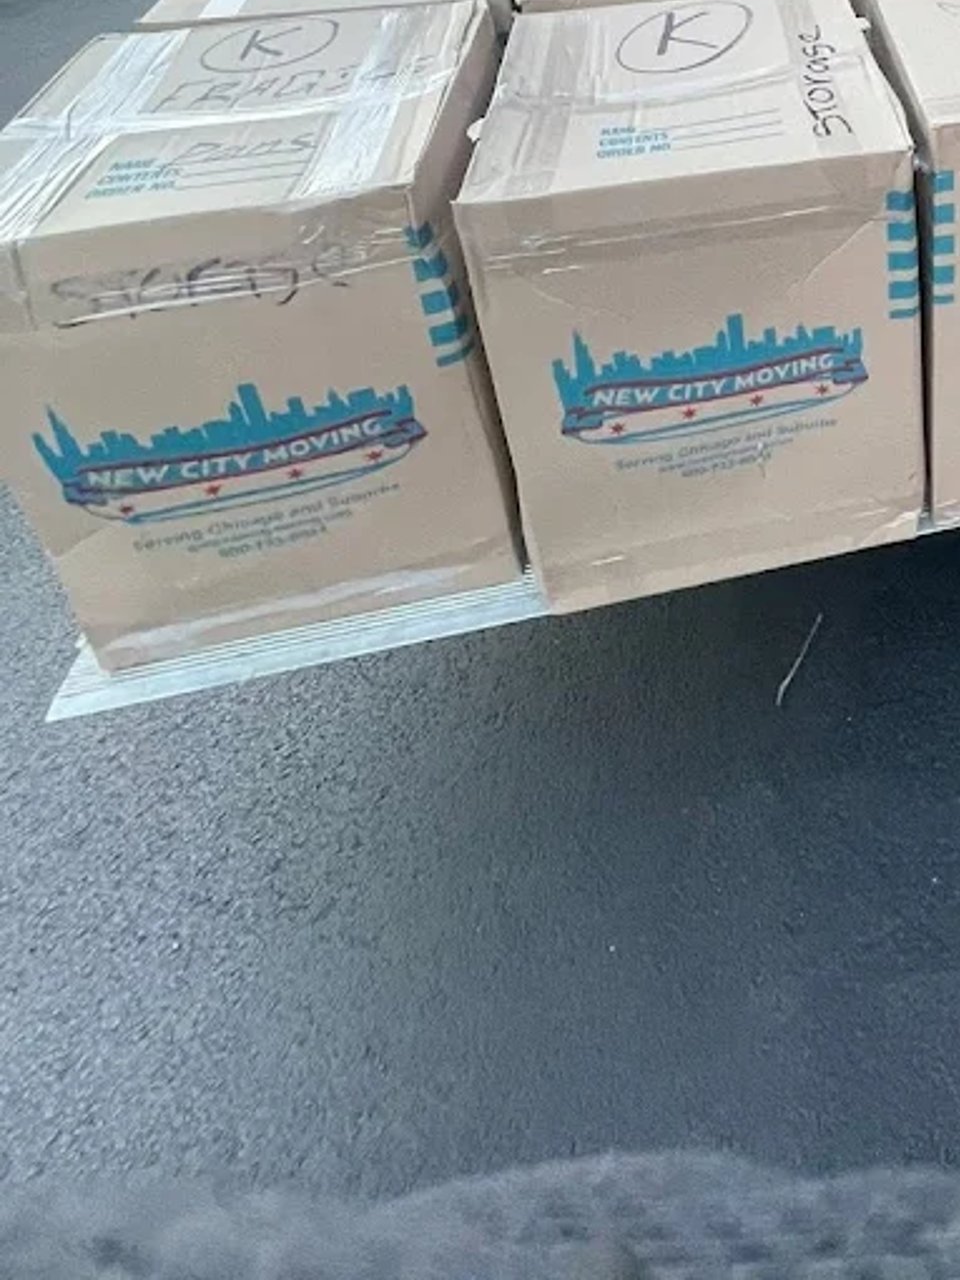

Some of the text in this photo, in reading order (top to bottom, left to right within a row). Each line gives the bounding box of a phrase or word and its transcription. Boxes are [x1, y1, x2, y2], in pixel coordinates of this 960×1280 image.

[238, 27, 304, 61] K
[657, 11, 719, 56] K
[591, 352, 835, 409] NEW CITY MOVING
[86, 417, 385, 490] NEW CITY MOVING
